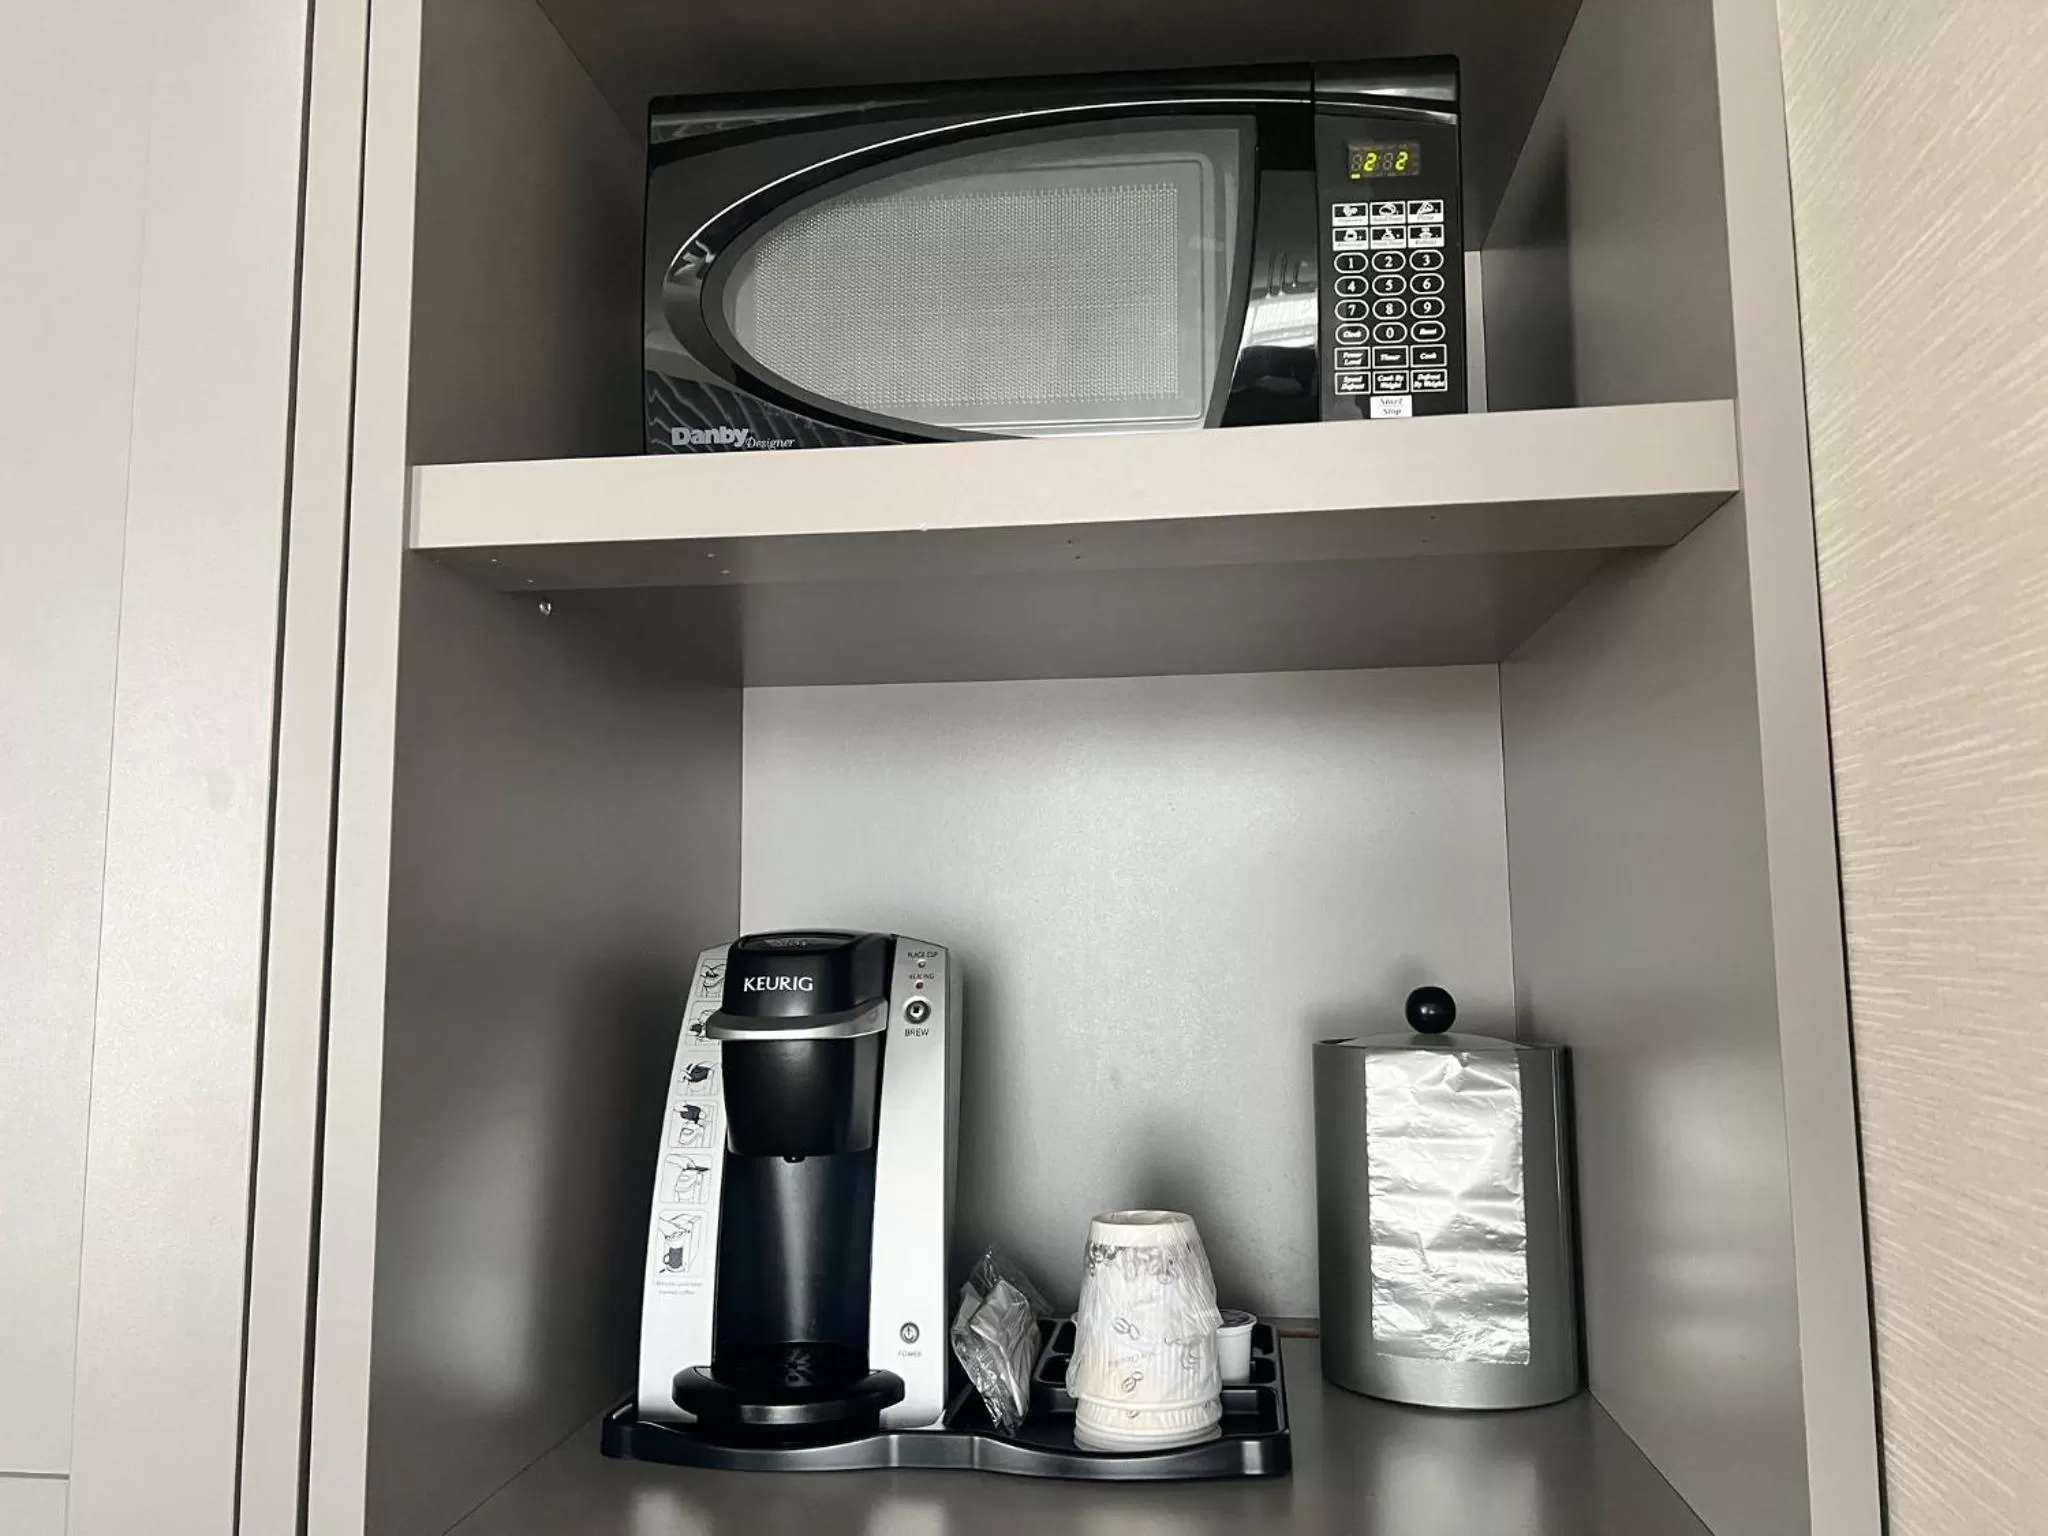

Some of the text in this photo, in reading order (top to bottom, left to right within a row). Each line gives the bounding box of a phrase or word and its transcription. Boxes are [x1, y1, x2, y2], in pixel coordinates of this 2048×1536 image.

[1348, 257, 1354, 269] 1
[1385, 255, 1393, 268] 2
[1422, 254, 1431, 266] 3
[1347, 280, 1356, 292] 4
[1385, 279, 1393, 291] 5
[1422, 278, 1431, 290] 6
[1347, 304, 1356, 316] 7
[1385, 303, 1393, 315] 8
[1423, 301, 1432, 314] 9
[1386, 327, 1394, 339] 0
[671, 425, 795, 450] Danby Designer
[743, 976, 814, 992] KEURIG
[904, 1028, 929, 1037] BREW
